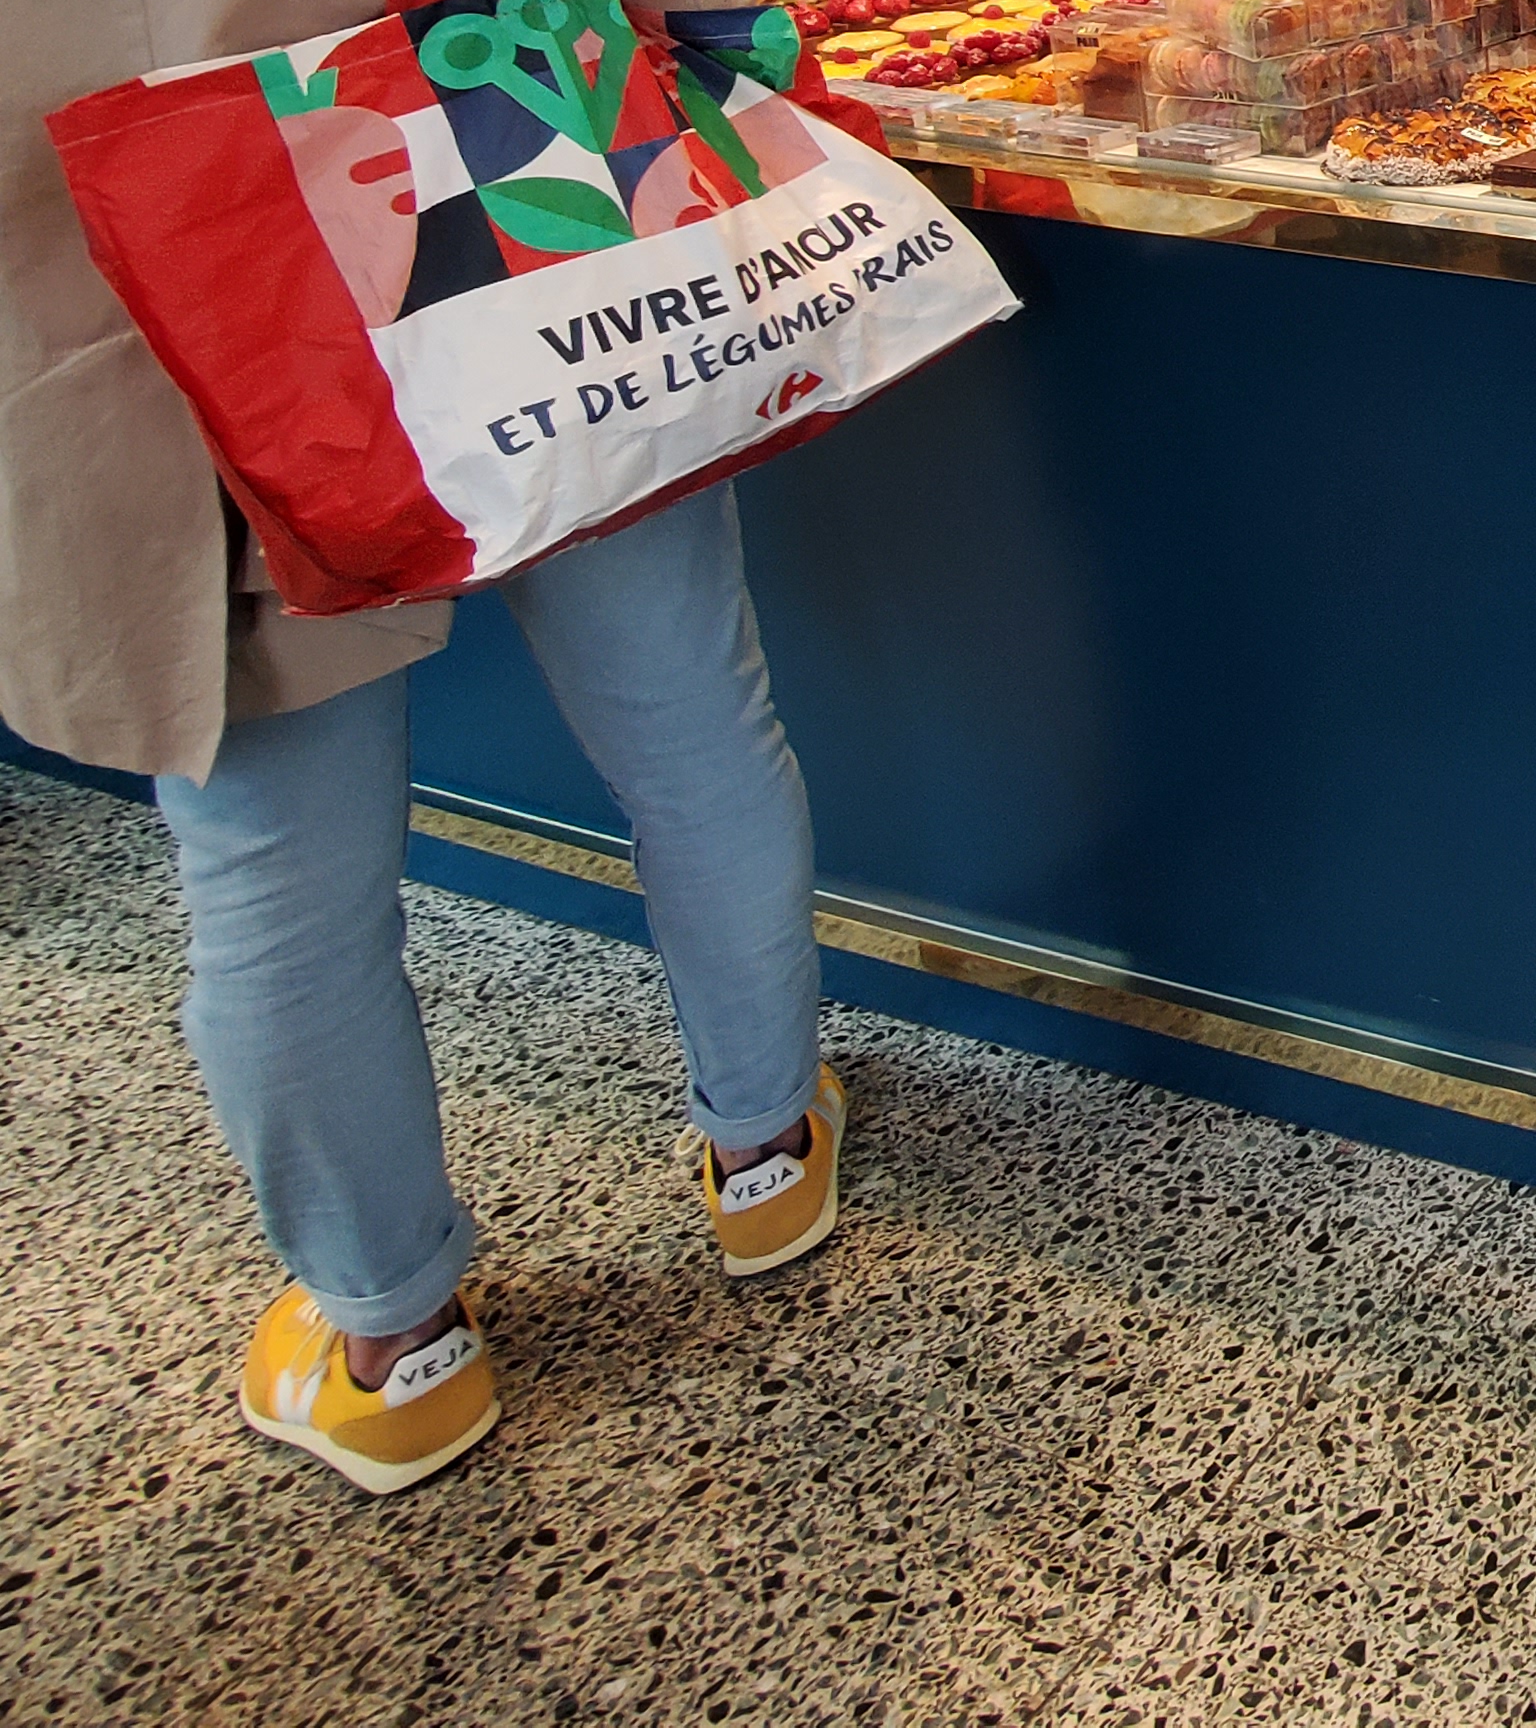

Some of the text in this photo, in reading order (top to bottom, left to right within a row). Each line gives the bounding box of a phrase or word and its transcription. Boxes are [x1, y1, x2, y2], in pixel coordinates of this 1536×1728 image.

[486, 220, 954, 456] ET DE LÉGUMES RAIS
[537, 275, 731, 365] VIVRE
[730, 1166, 794, 1201] VEJA
[398, 1338, 475, 1386] VEJA
